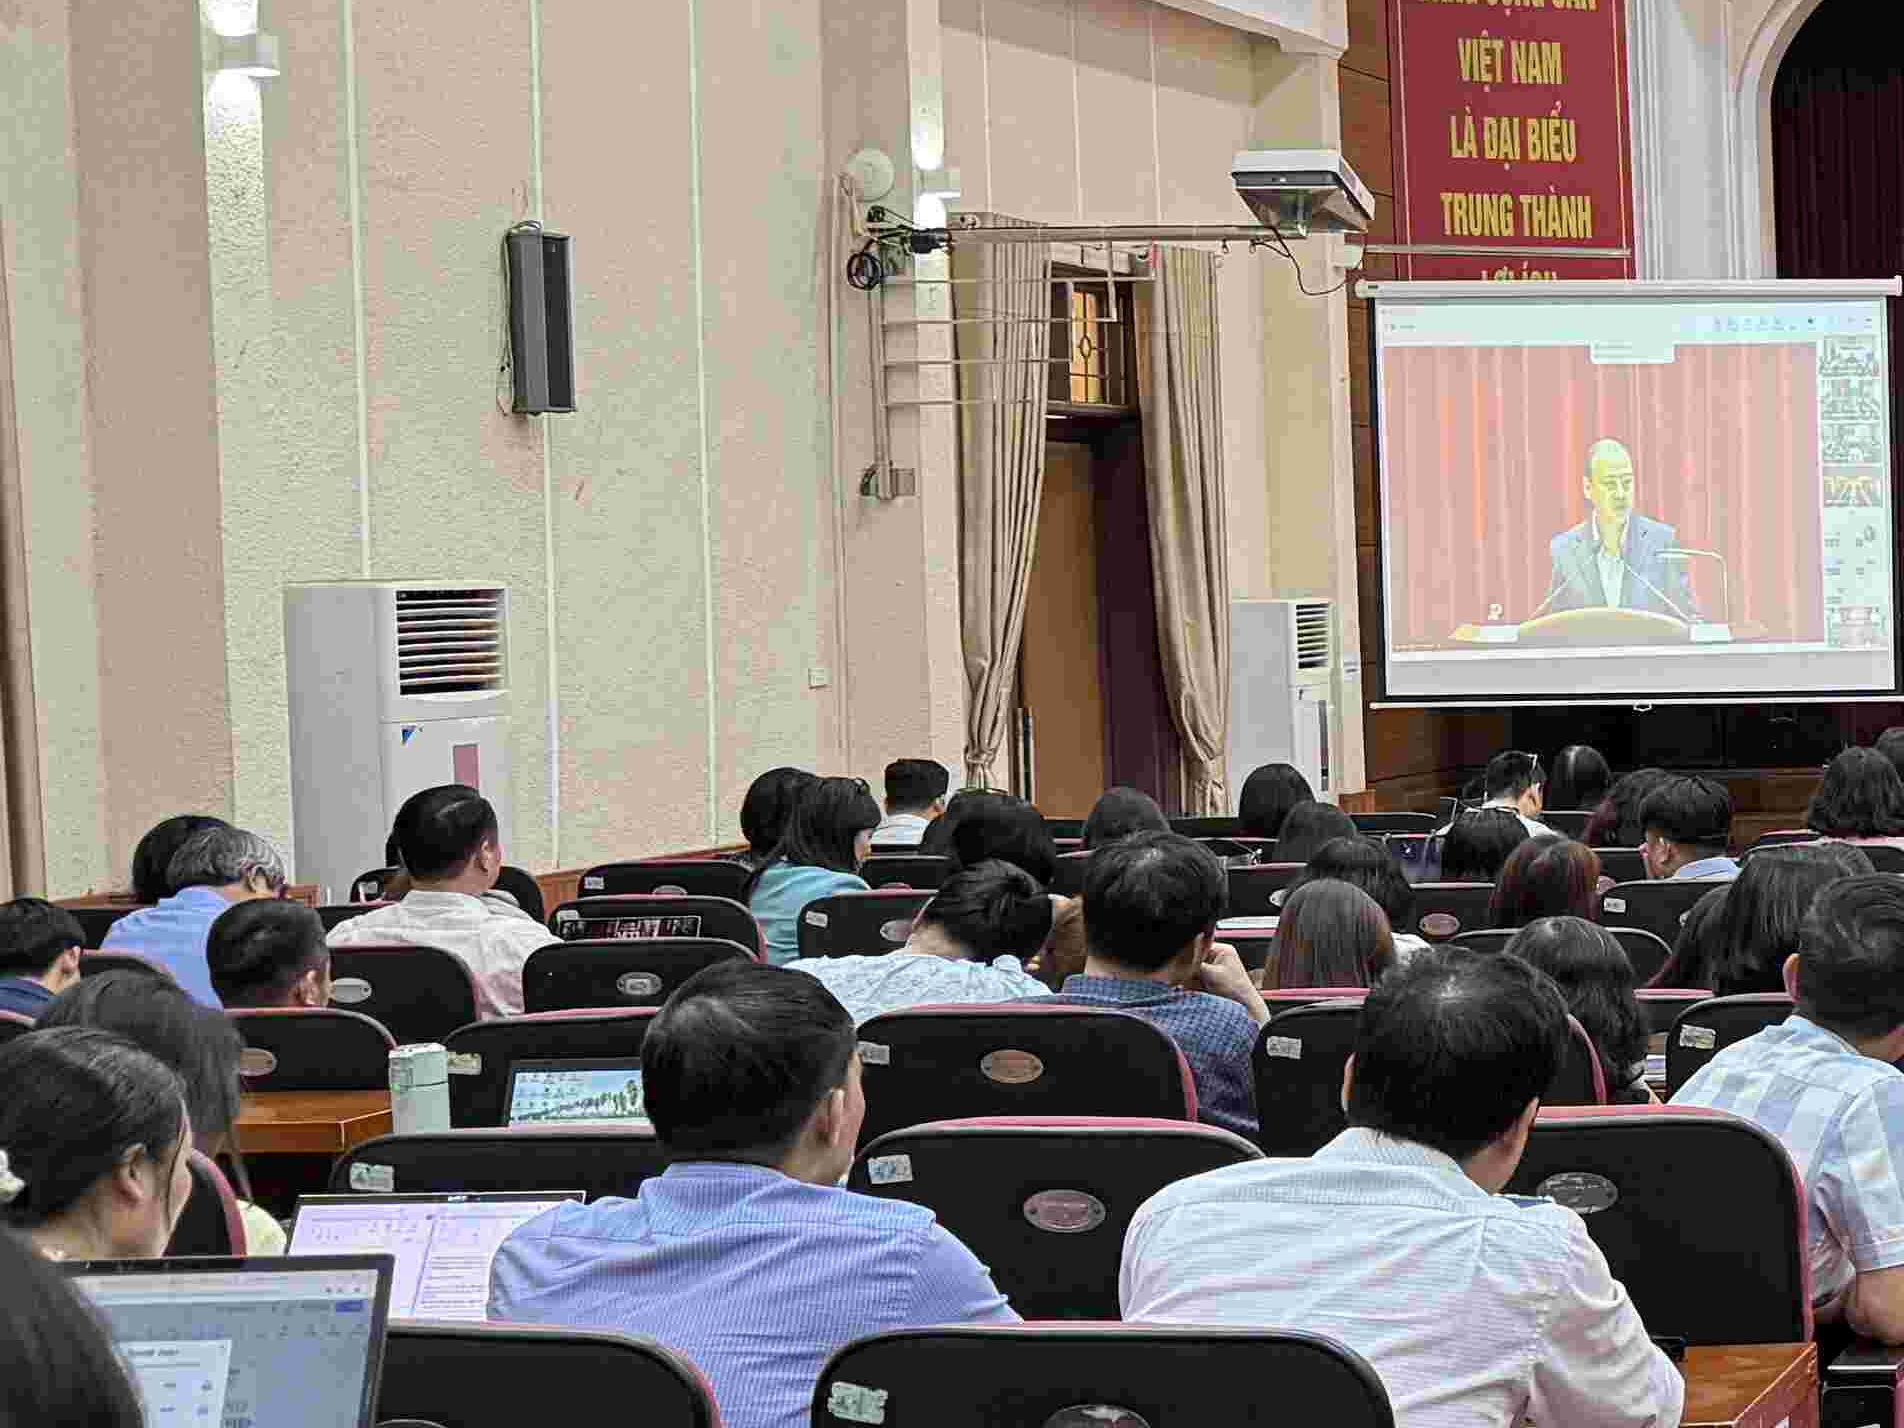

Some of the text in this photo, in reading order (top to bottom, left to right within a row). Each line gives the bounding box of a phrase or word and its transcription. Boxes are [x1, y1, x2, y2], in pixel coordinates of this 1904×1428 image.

[1458, 30, 1562, 92] VIỆT NAM
[1450, 101, 1577, 171] LÀ ĐẠI BIỂU
[1440, 184, 1593, 238] TRUNG THÀNH
